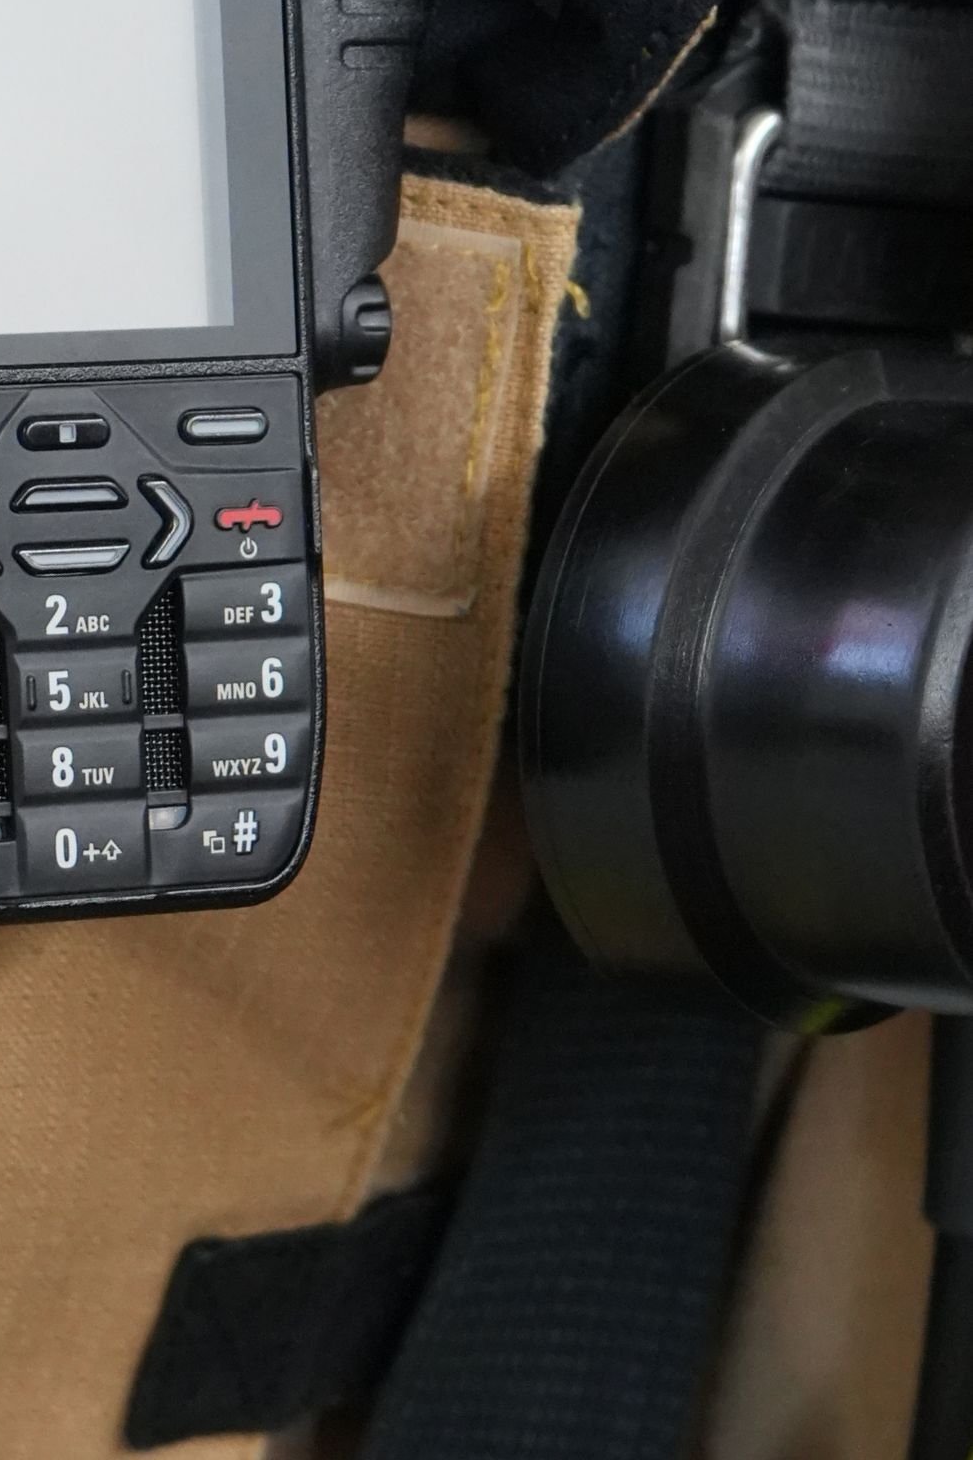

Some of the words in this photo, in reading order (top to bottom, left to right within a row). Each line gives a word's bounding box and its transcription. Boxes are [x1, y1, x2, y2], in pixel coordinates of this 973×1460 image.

[46, 595, 68, 635] 2
[76, 615, 110, 633] ABC
[224, 606, 254, 624] DEF
[260, 583, 282, 623] 3
[48, 671, 71, 711] 5
[79, 692, 109, 709] JKL
[217, 682, 257, 700] MNO
[262, 658, 283, 698] 6
[52, 747, 74, 787] 8
[82, 767, 115, 785] TUV
[213, 758, 261, 776] WXYZ
[264, 733, 286, 773] 9
[56, 828, 77, 868] 0
